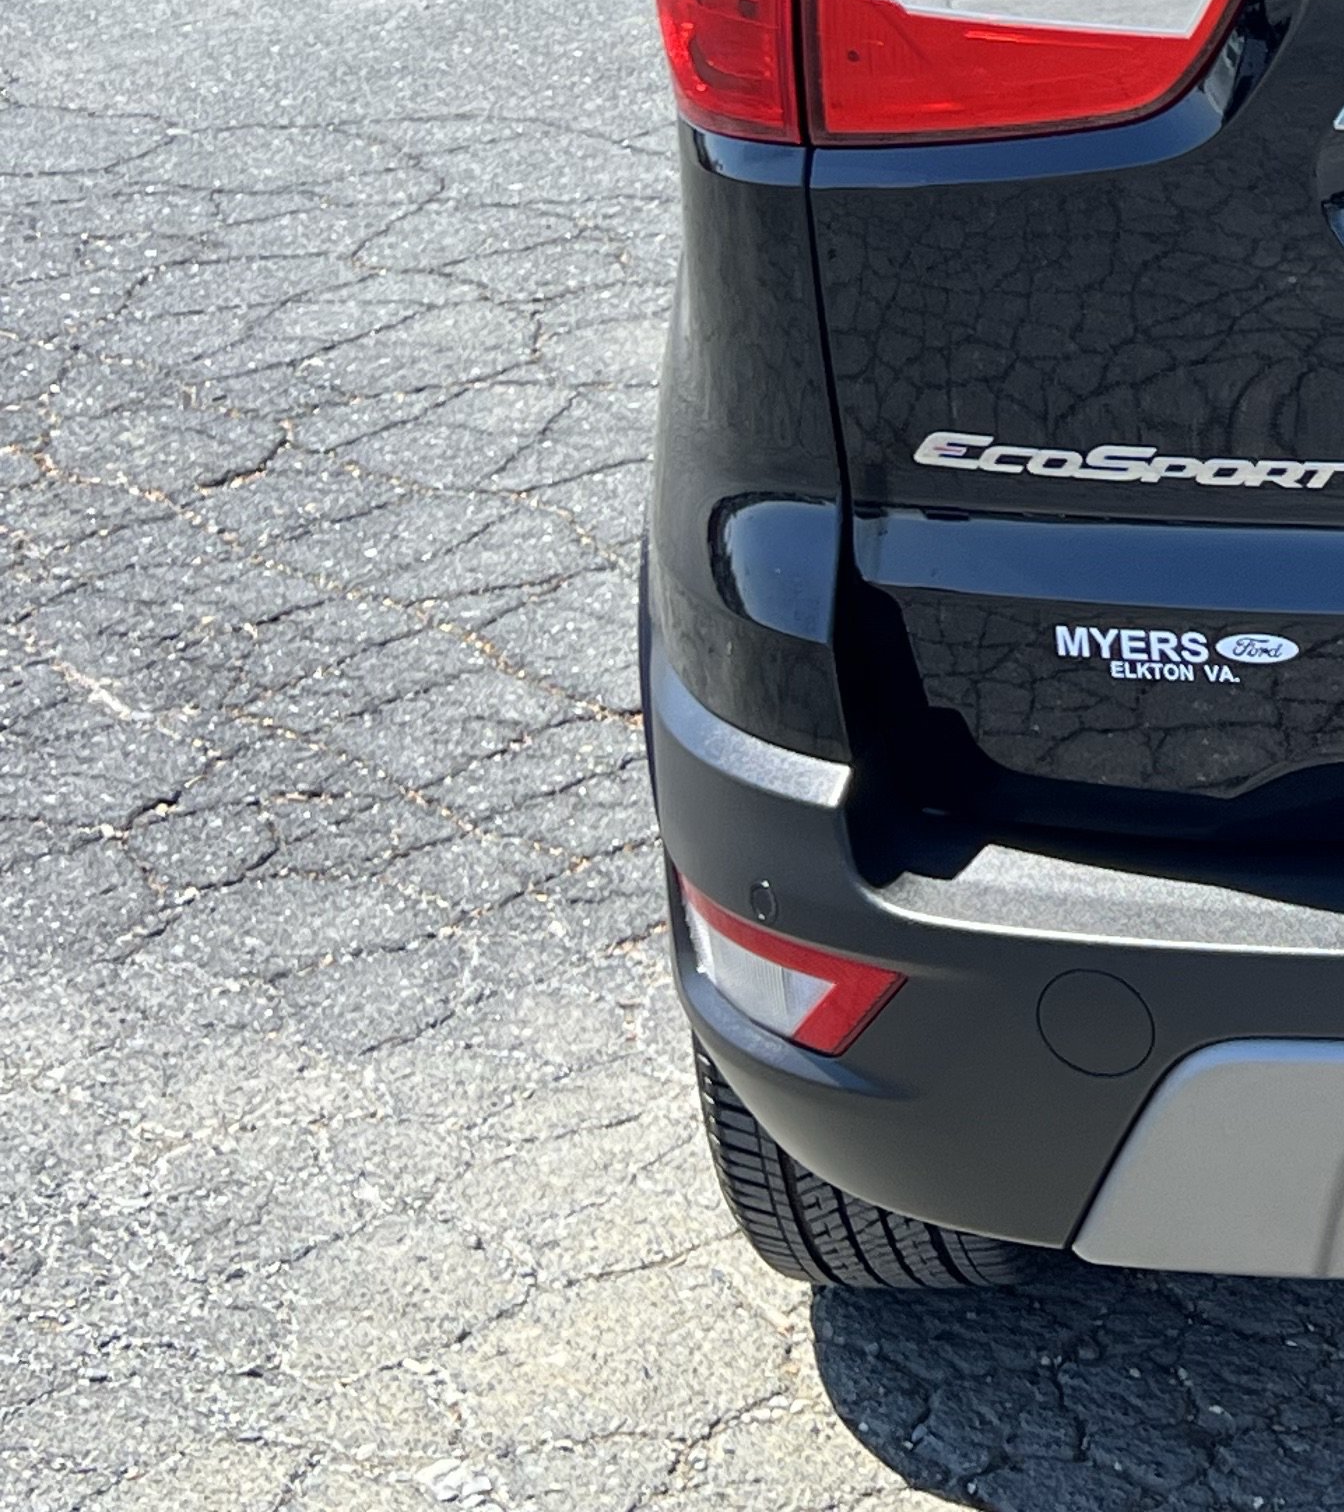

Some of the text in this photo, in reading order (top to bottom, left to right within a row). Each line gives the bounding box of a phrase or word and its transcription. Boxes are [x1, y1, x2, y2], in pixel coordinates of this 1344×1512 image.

[1055, 625, 1284, 663] MYERS Ford
[1110, 661, 1241, 683] ELKTON VA.
